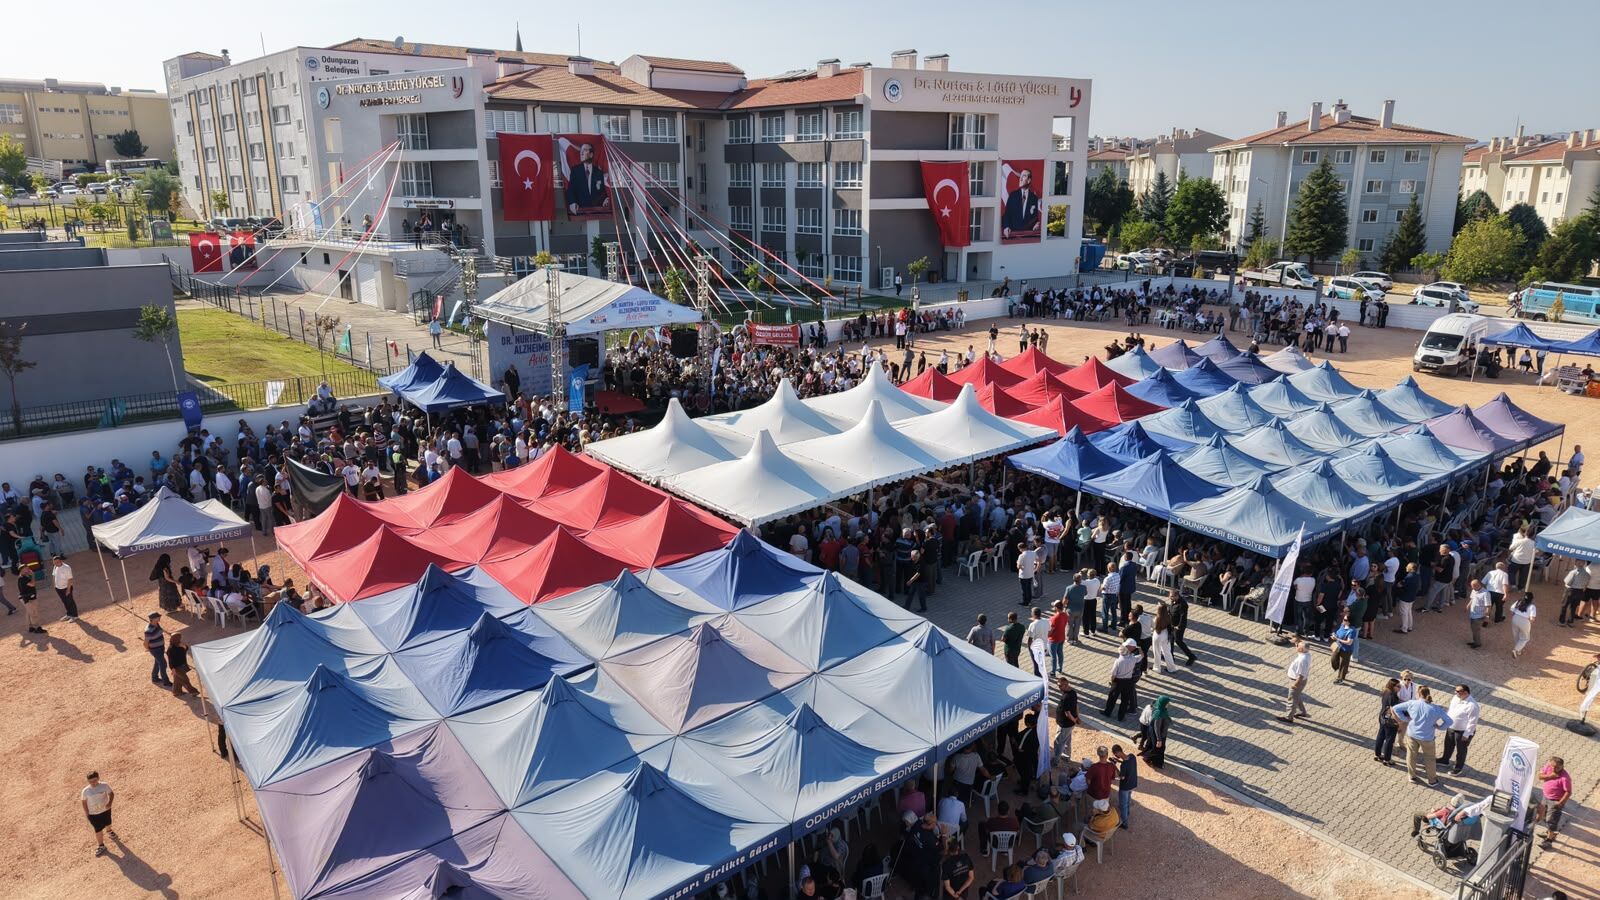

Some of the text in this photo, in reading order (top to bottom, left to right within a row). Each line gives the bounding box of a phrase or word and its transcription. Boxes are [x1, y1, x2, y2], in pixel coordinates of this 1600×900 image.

[321, 56, 359, 66] Odunpazarı
[325, 65, 360, 75] Belediyesi
[336, 84, 348, 95] Dr.
[410, 75, 445, 89] YÜKSEL
[914, 77, 931, 90] Dr.
[976, 81, 984, 92] &
[1018, 80, 1059, 96] YÜKSEL
[501, 333, 540, 346] DR. NURTEN
[514, 342, 551, 354] ALZHEIME
[130, 529, 242, 552] ODUNPAZARI BELEDİYESİ
[1177, 517, 1271, 553] ODUNPAZARI BELEDİYESİ
[946, 690, 1040, 752] ODUNPAZARI BELEDİYESİ
[805, 756, 927, 829] ODUNPAZARI BELEDİYESİ
[704, 856, 746, 883] Birlikte
[749, 836, 778, 858] Güzel
